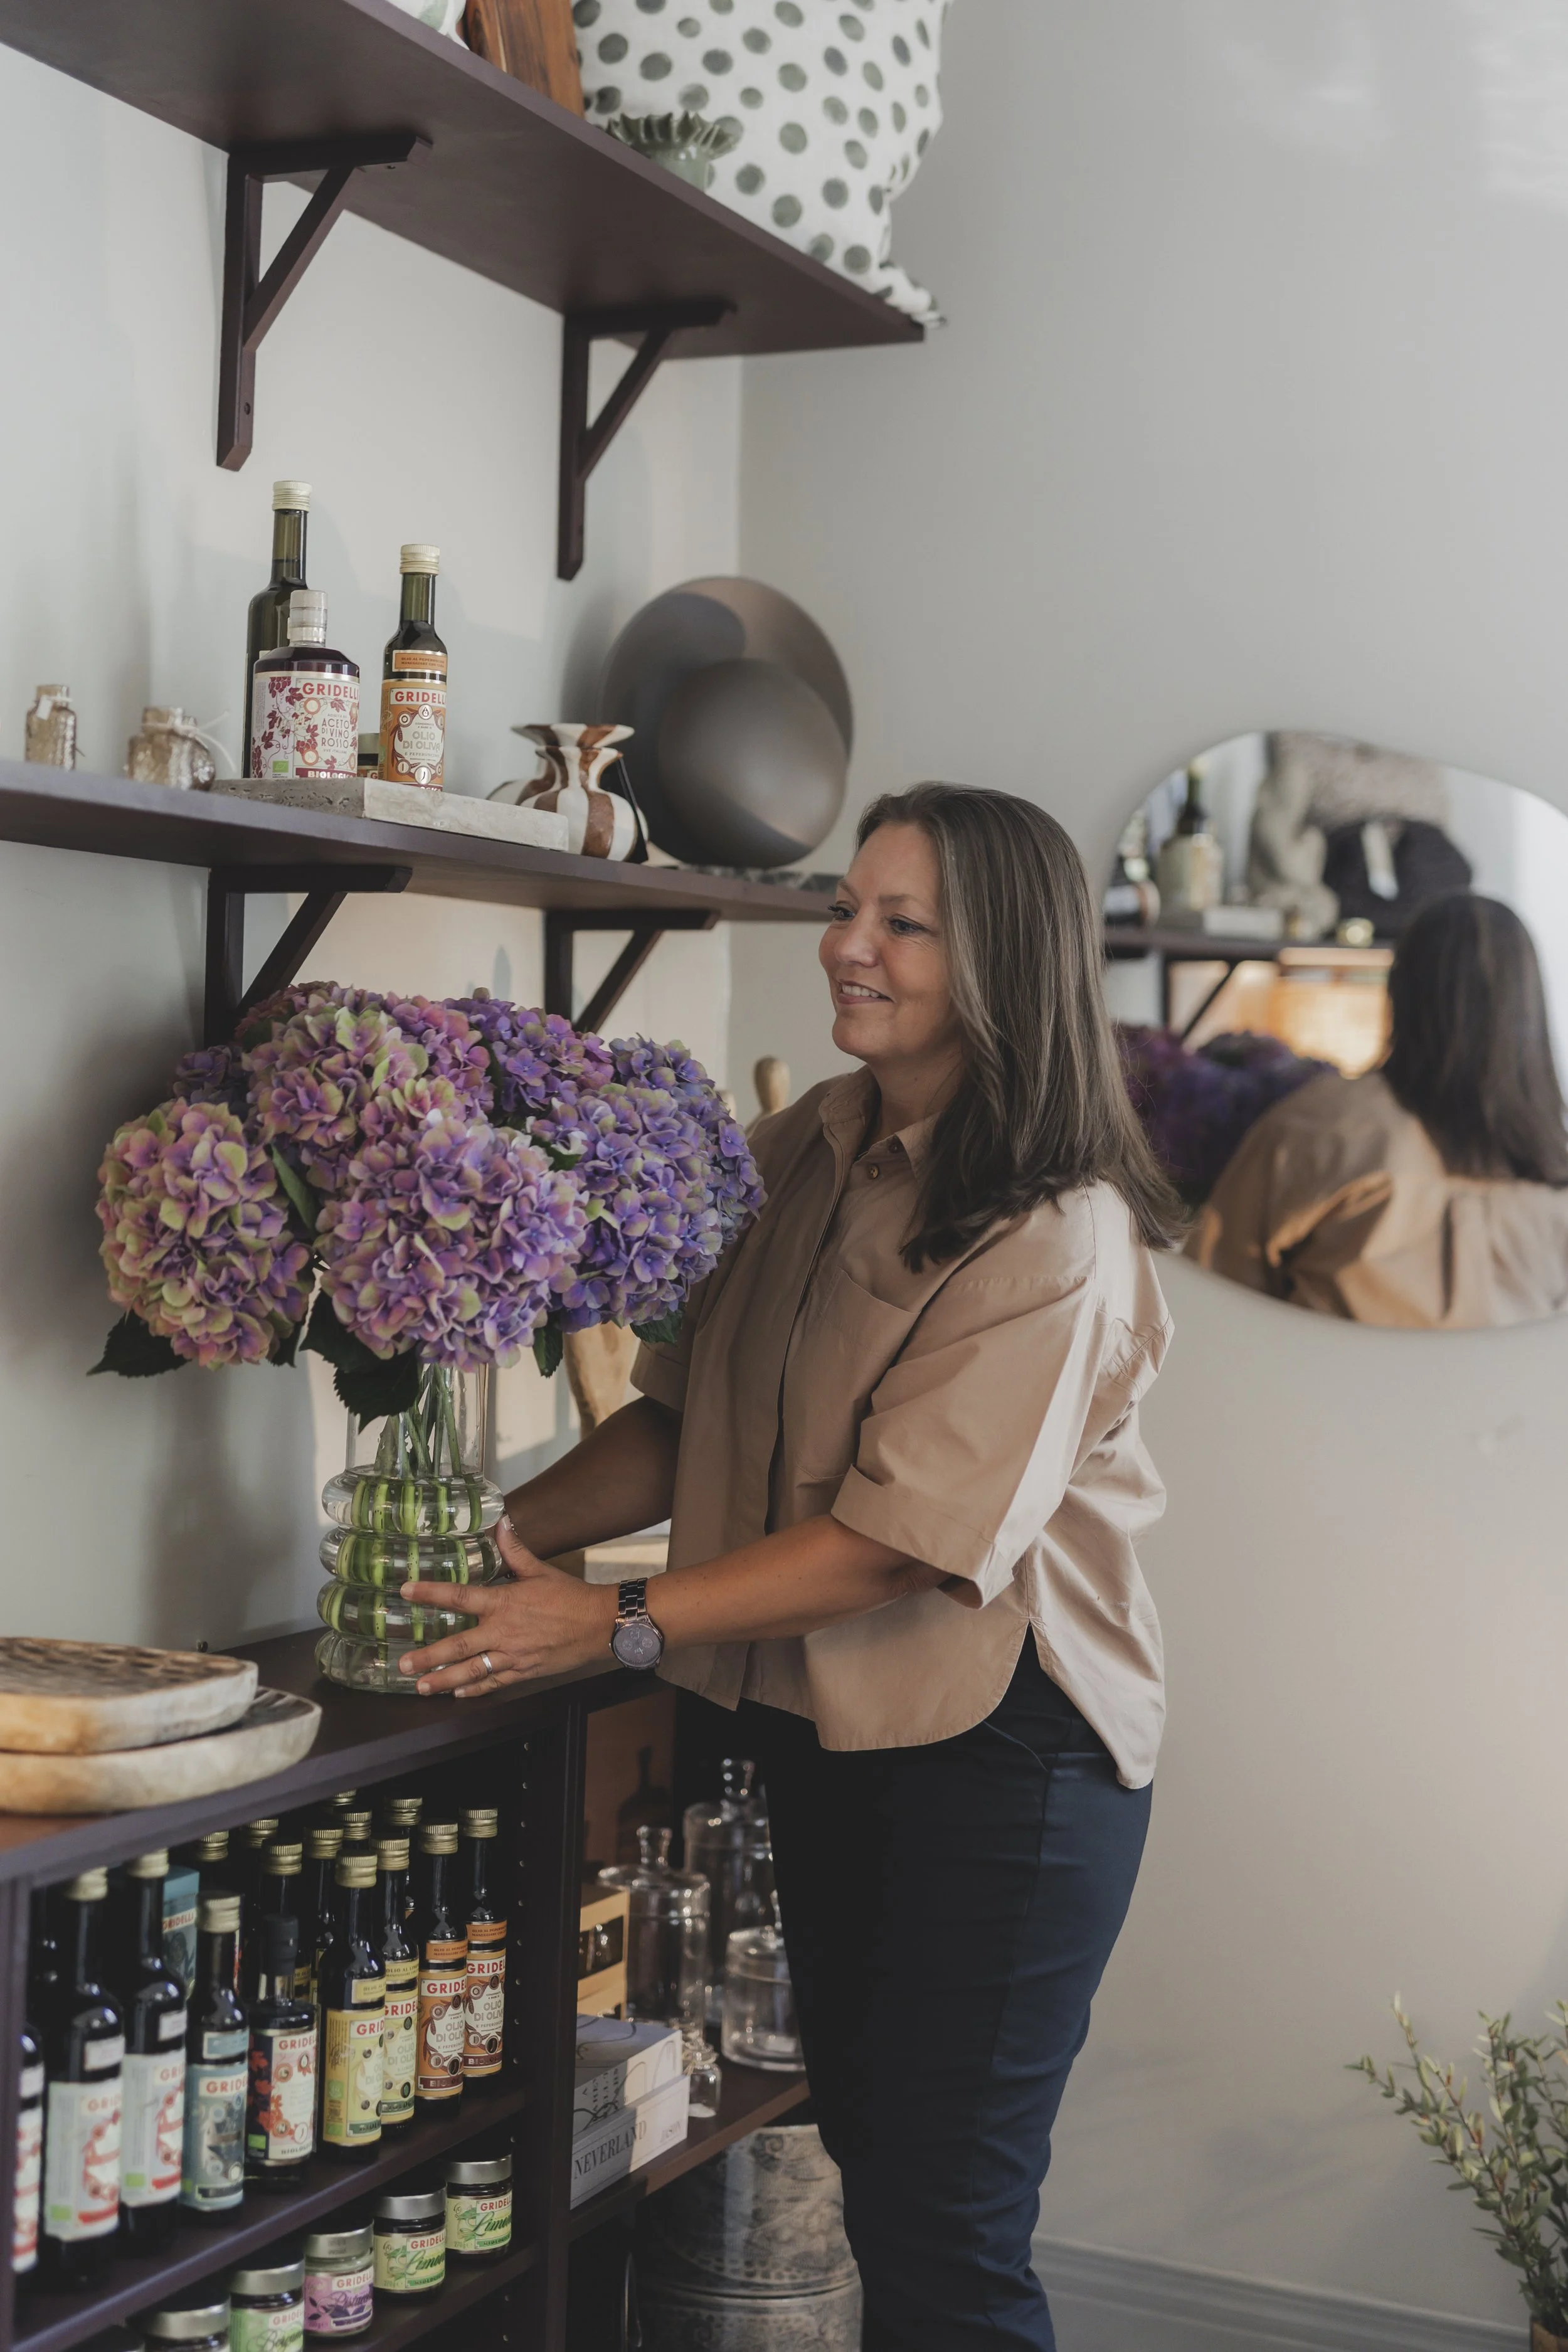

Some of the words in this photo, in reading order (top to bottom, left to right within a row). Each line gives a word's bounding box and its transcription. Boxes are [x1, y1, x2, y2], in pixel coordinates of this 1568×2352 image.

[322, 718, 349, 729] ACETO
[330, 728, 349, 739] VINO
[412, 731, 436, 740] OLIO
[321, 738, 349, 748] ROSSO
[402, 740, 413, 750] DI
[415, 741, 440, 753] OLIVA
[484, 2000, 502, 2011] OLIO
[474, 2012, 484, 2021] DI
[445, 2020, 464, 2032] OLIO
[436, 2033, 446, 2042] DI
[388, 2056, 398, 2065] DI
[573, 2120, 647, 2180] NEVERLAND
